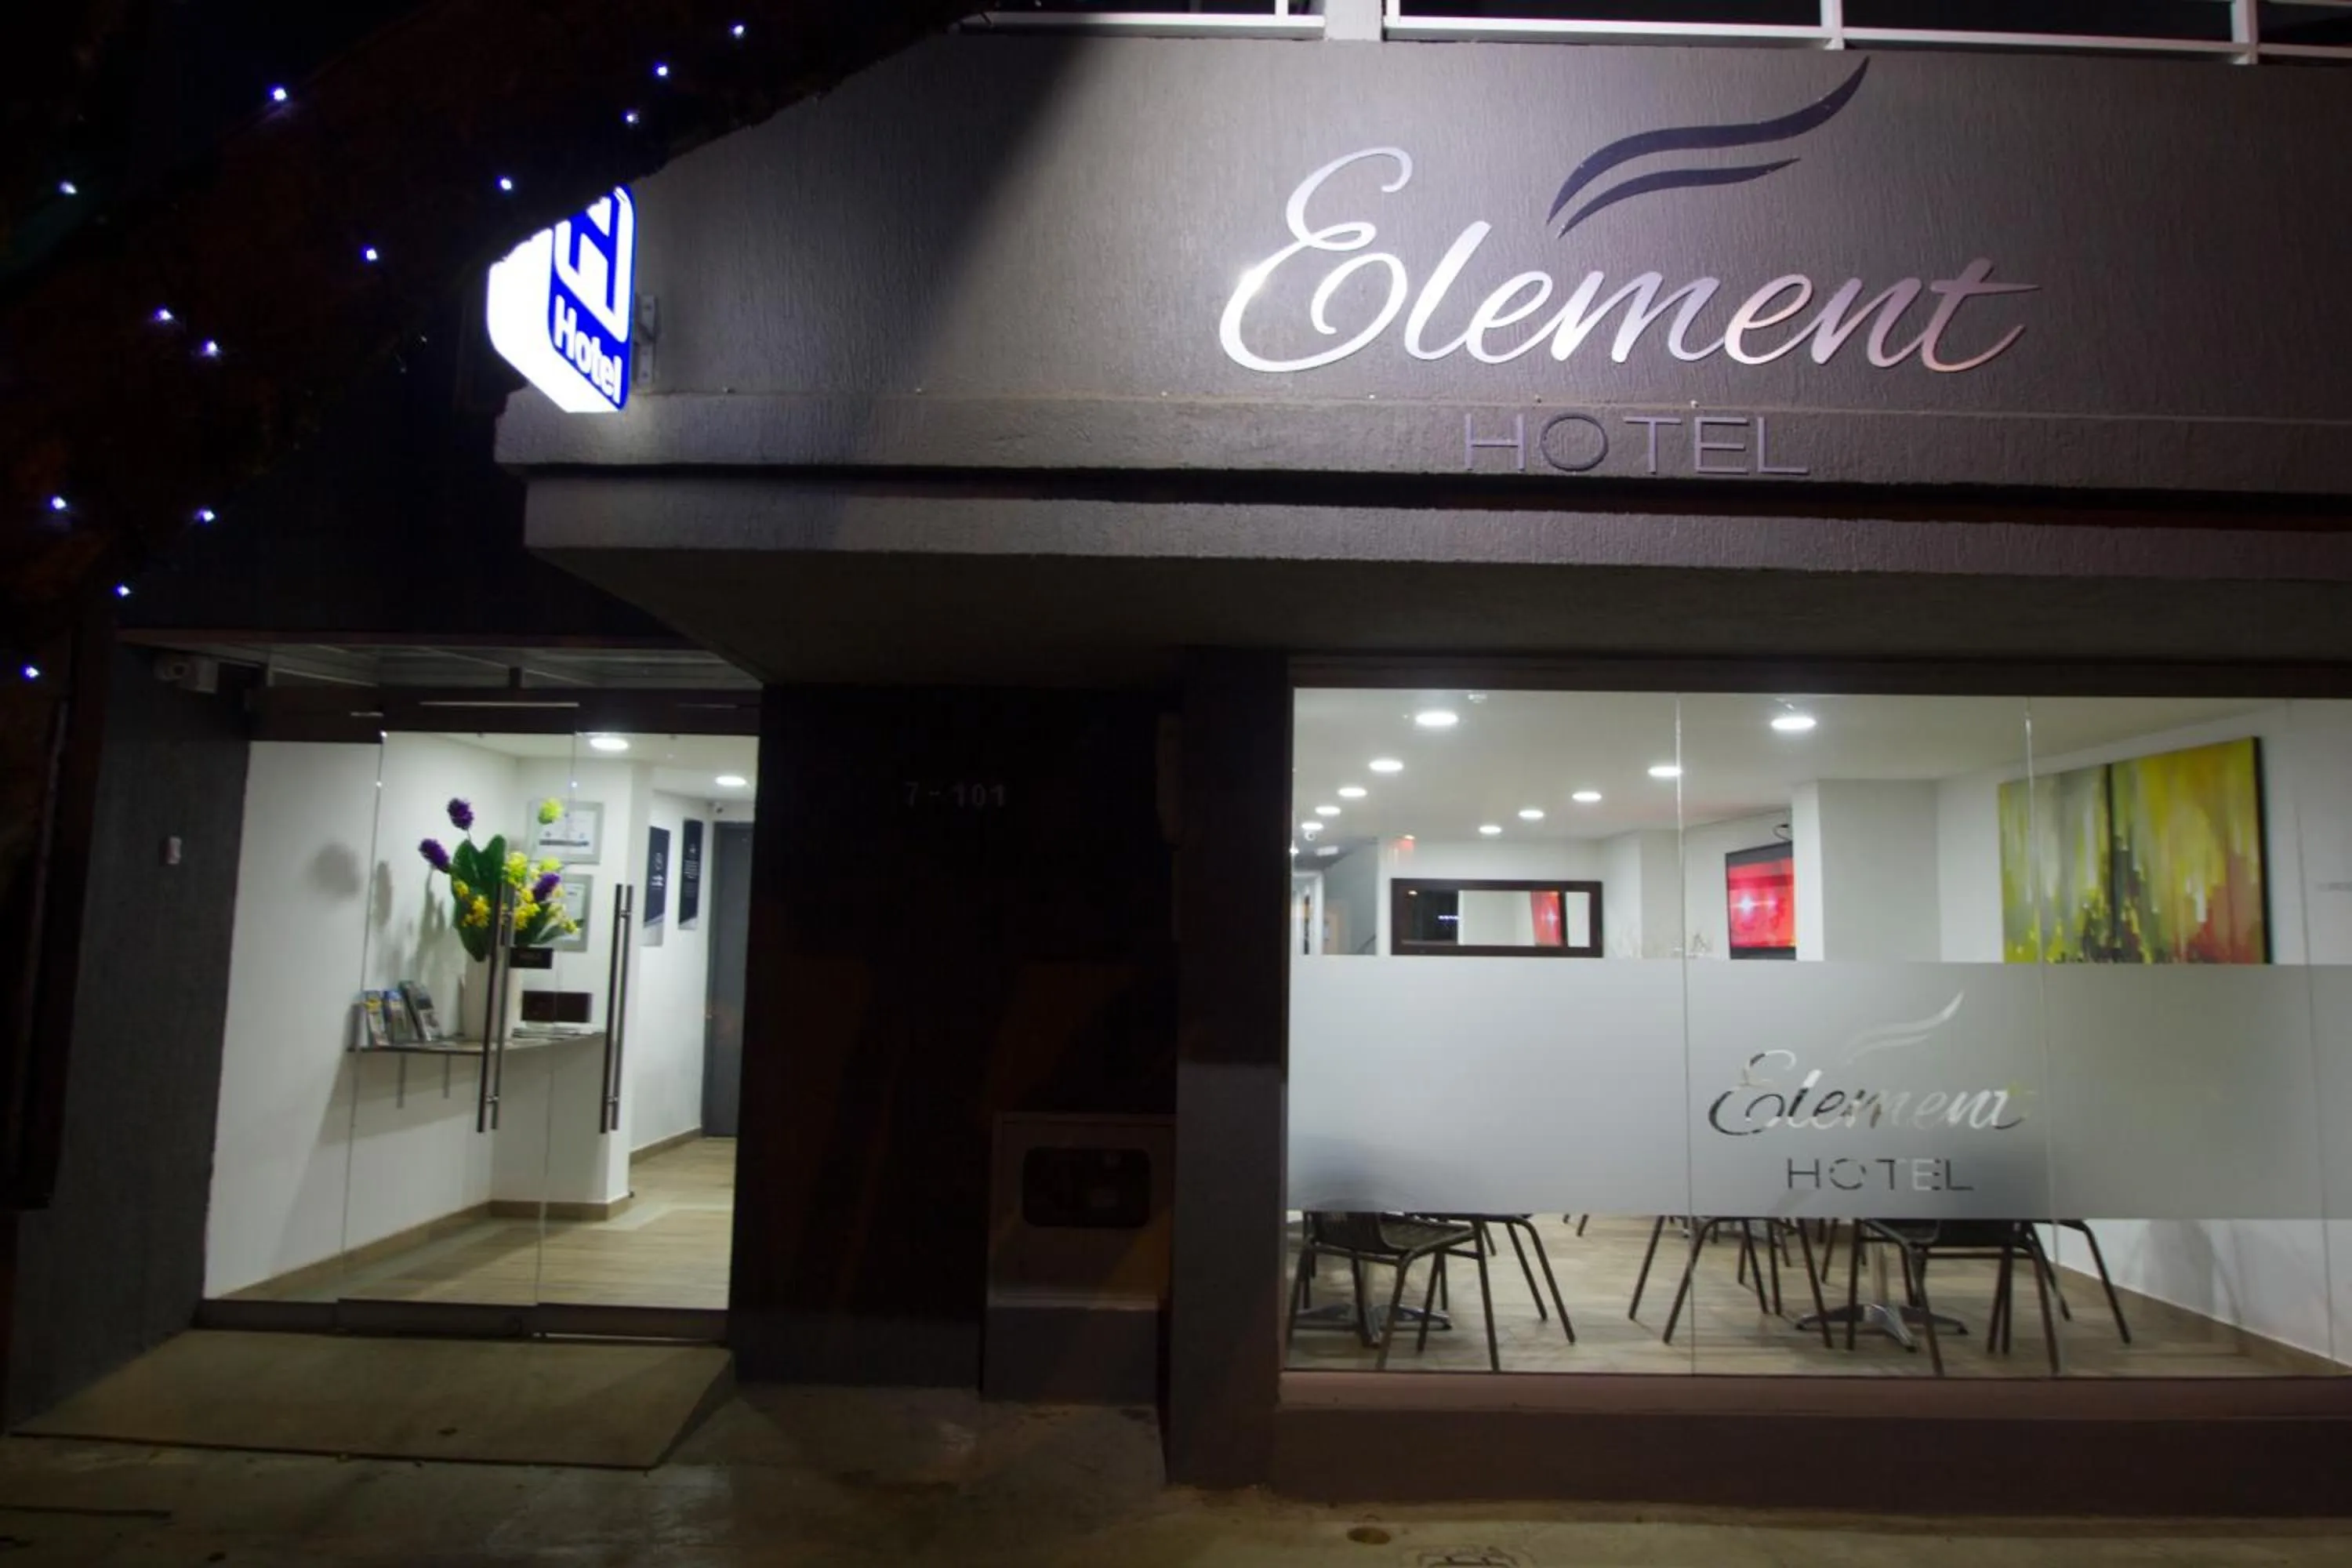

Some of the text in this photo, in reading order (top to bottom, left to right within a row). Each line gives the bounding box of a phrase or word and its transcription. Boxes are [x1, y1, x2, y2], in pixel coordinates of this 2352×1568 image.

[1219, 146, 2040, 373] Element
[554, 294, 622, 405] Hotel
[1463, 412, 1809, 477] HOTEL
[1708, 1049, 2036, 1136] Element
[1788, 1157, 1974, 1192] HOTEL
